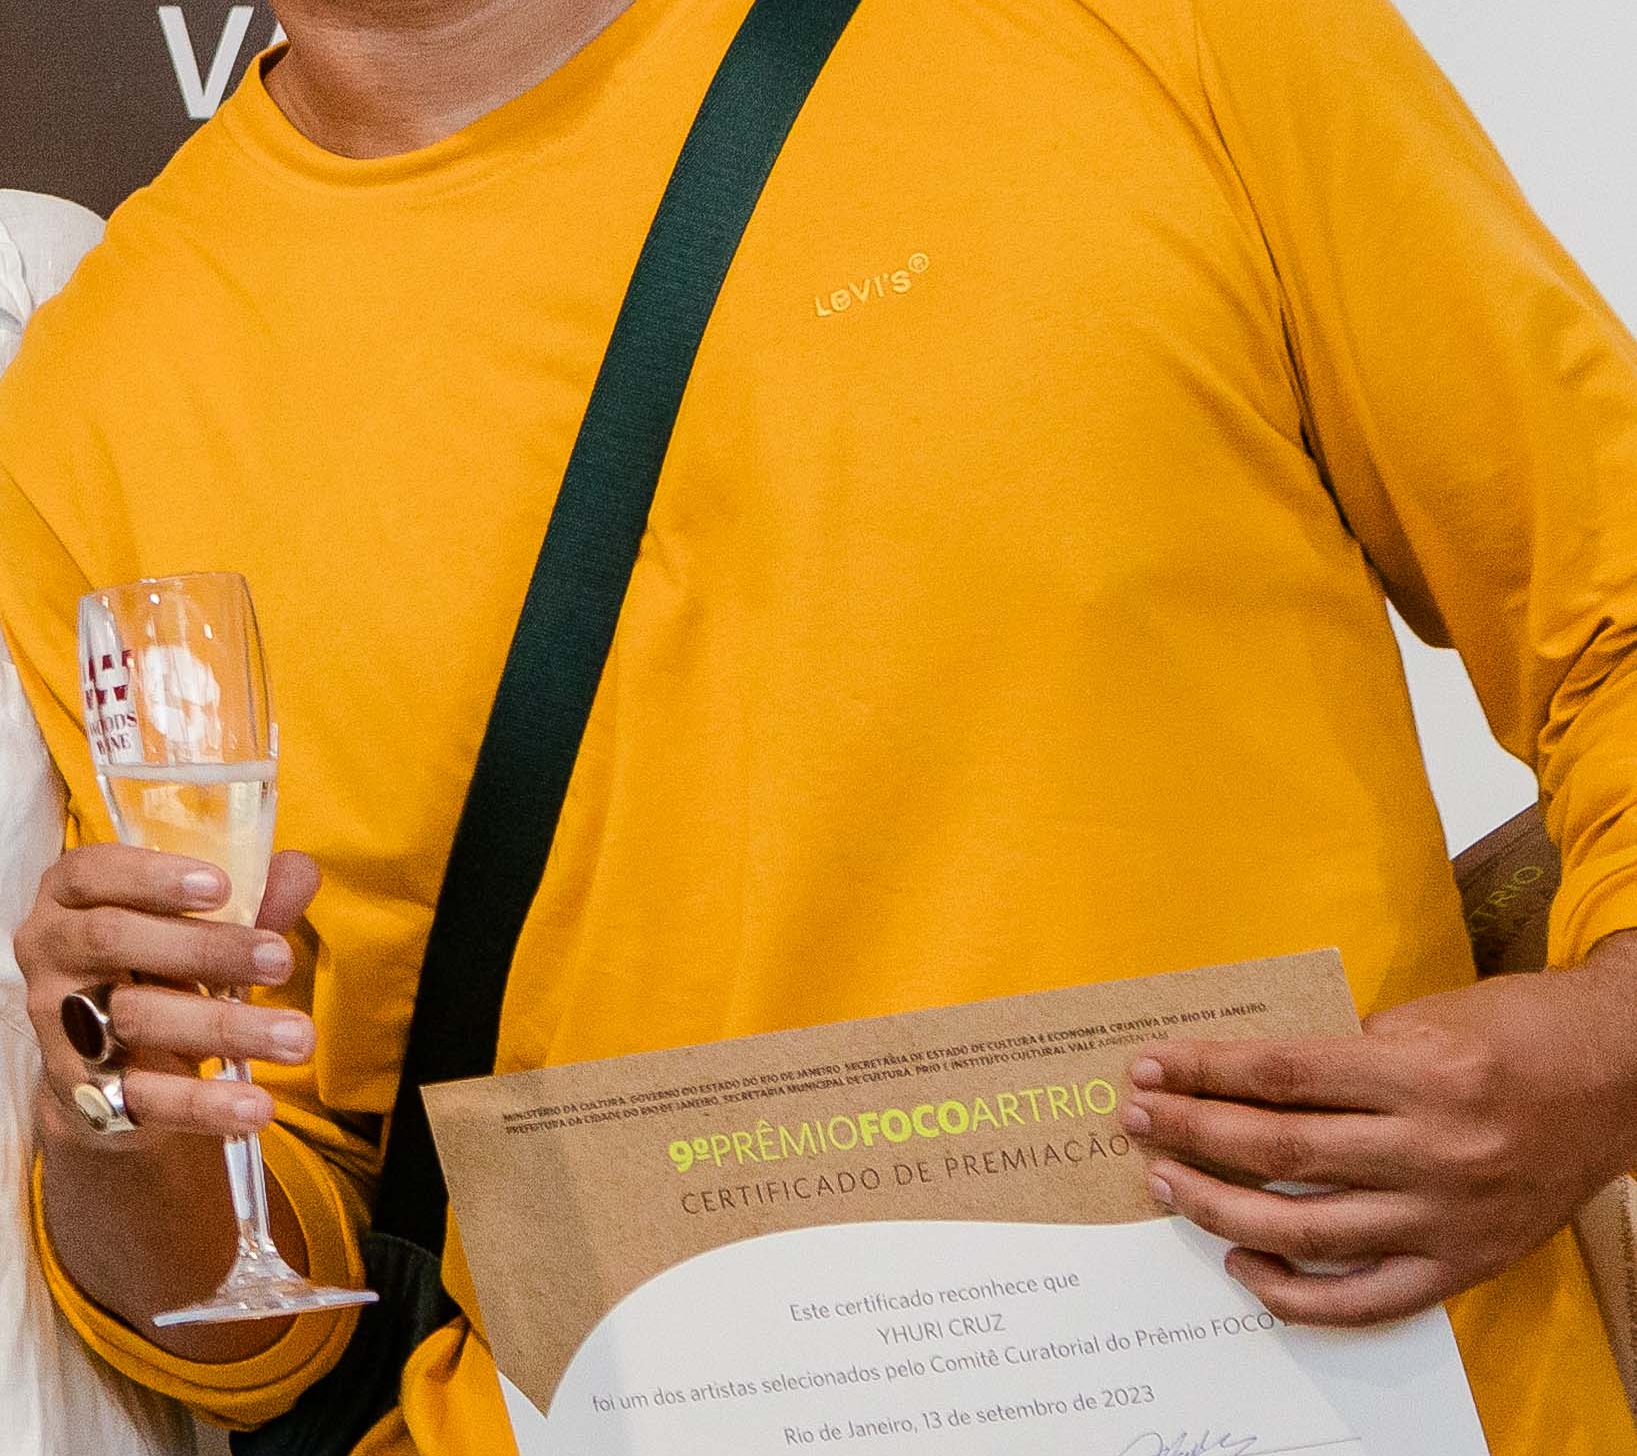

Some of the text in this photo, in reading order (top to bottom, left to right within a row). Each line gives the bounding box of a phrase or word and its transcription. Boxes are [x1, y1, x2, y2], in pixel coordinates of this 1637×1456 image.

[679, 1125, 1130, 1215] CERTIFICADO DE PREMIAÇÃO
[788, 1272, 1080, 1322] Este certificado reconhece que
[591, 1303, 1275, 1412] foi um dos artistas selecionados pelo Comitê Curatorial do Prêmio FOCO
[875, 1312, 1006, 1345] YHURI CRUZ
[782, 1383, 1155, 1445] Rio de Janeiro, 13 de setembro de 2023
